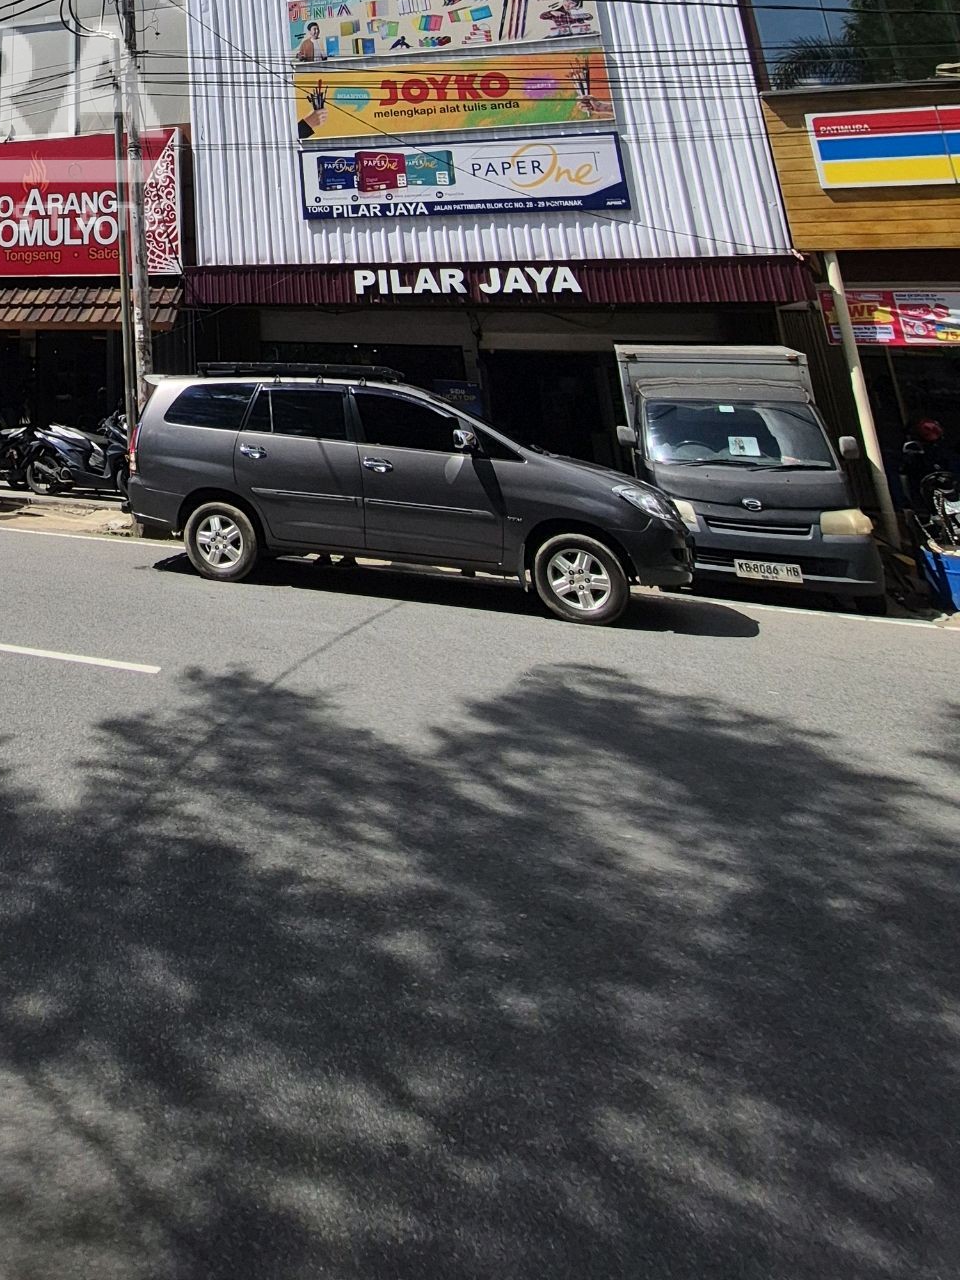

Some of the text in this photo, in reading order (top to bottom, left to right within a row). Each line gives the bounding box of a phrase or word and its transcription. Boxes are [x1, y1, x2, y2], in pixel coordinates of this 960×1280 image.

[379, 71, 510, 106] JOYKO
[373, 100, 520, 119] melengkapi alat tulis anda
[820, 123, 871, 134] PATIMURA
[22, 188, 118, 217] ARANG
[332, 204, 381, 218] PILAR
[386, 202, 429, 216] JAYA
[453, 202, 486, 211] PATTIMURA
[487, 201, 503, 209] BLOK
[504, 201, 514, 209] CC
[514, 201, 525, 209] NO.
[545, 199, 583, 207] PONTIANAK
[4, 249, 61, 264] Tongseng
[89, 247, 119, 261] Sate
[353, 266, 583, 295] PILAR JAYA
